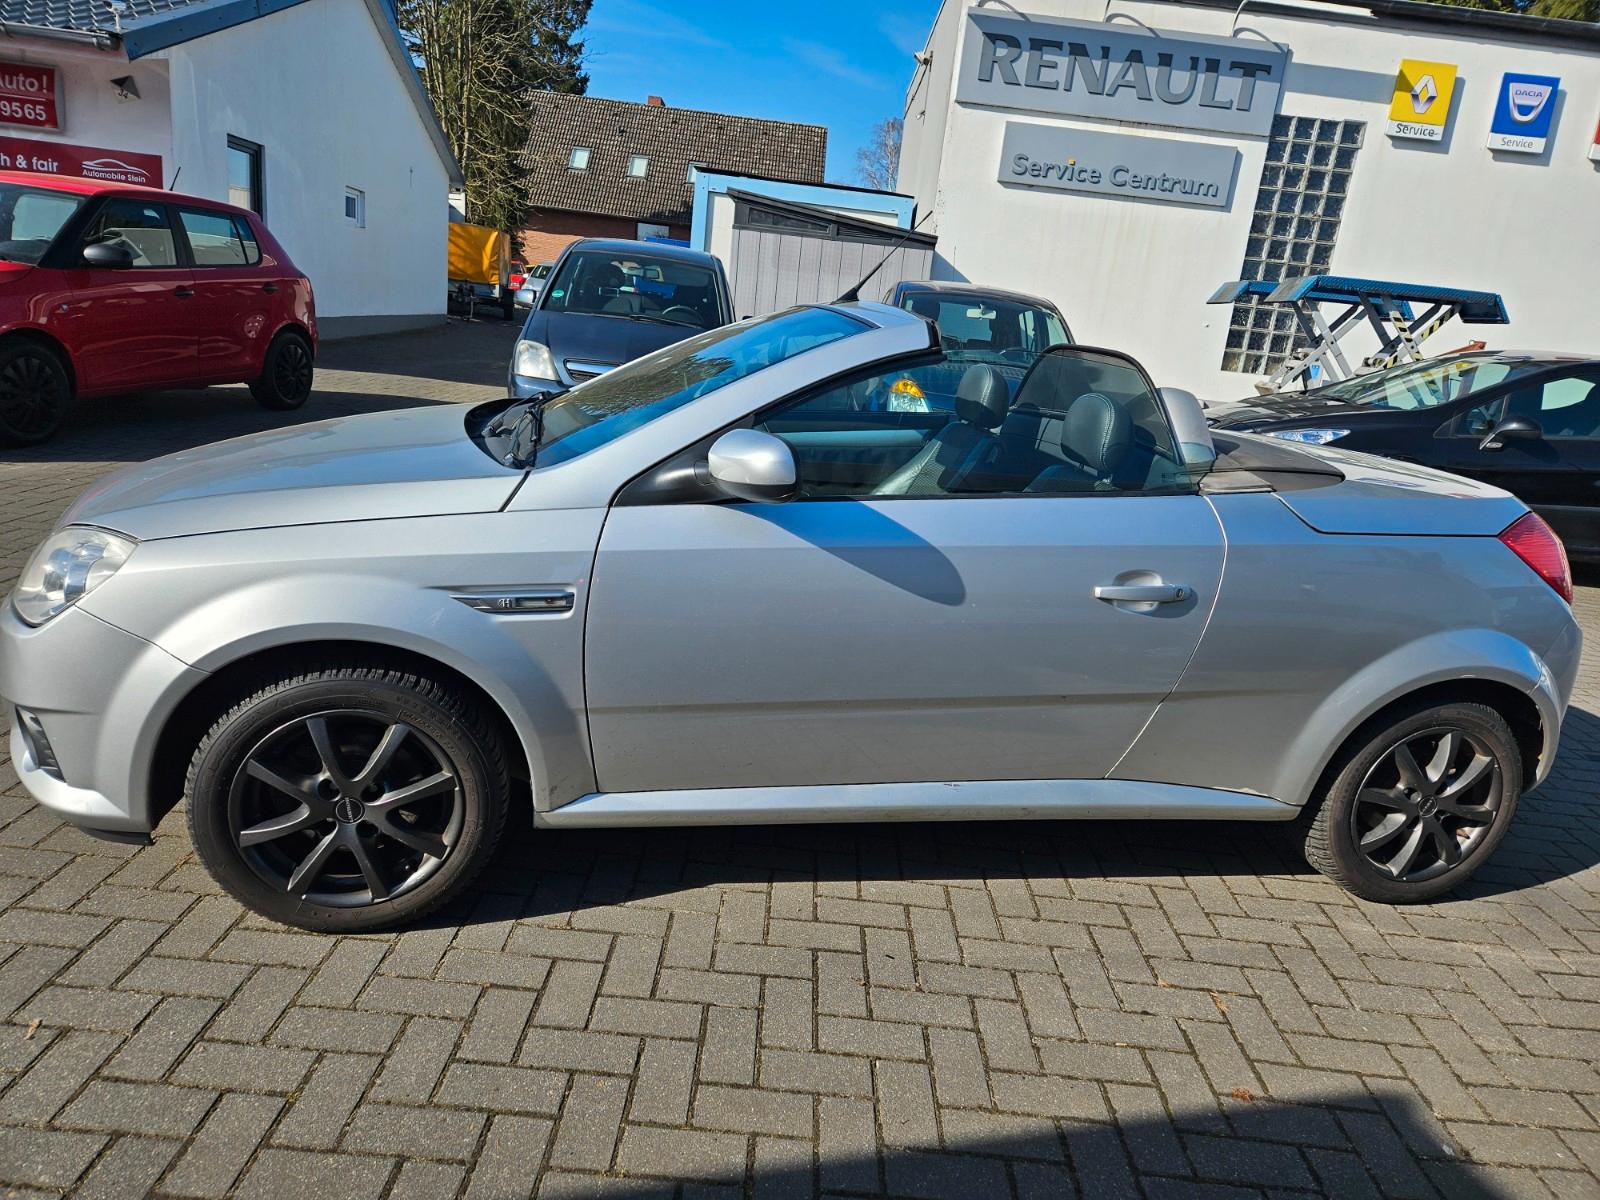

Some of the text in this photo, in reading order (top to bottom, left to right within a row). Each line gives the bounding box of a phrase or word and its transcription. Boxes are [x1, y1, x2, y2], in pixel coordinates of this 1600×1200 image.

[977, 31, 1273, 112] RENAULT
[1514, 89, 1544, 98] DACIA
[0, 100, 47, 121] 9565
[1395, 123, 1436, 138] Service
[1500, 136, 1534, 149] Service
[16, 154, 28, 169] &
[32, 156, 59, 172] fair
[82, 169, 146, 183] Automobile Stein
[1011, 153, 1219, 198] Service Centrum
